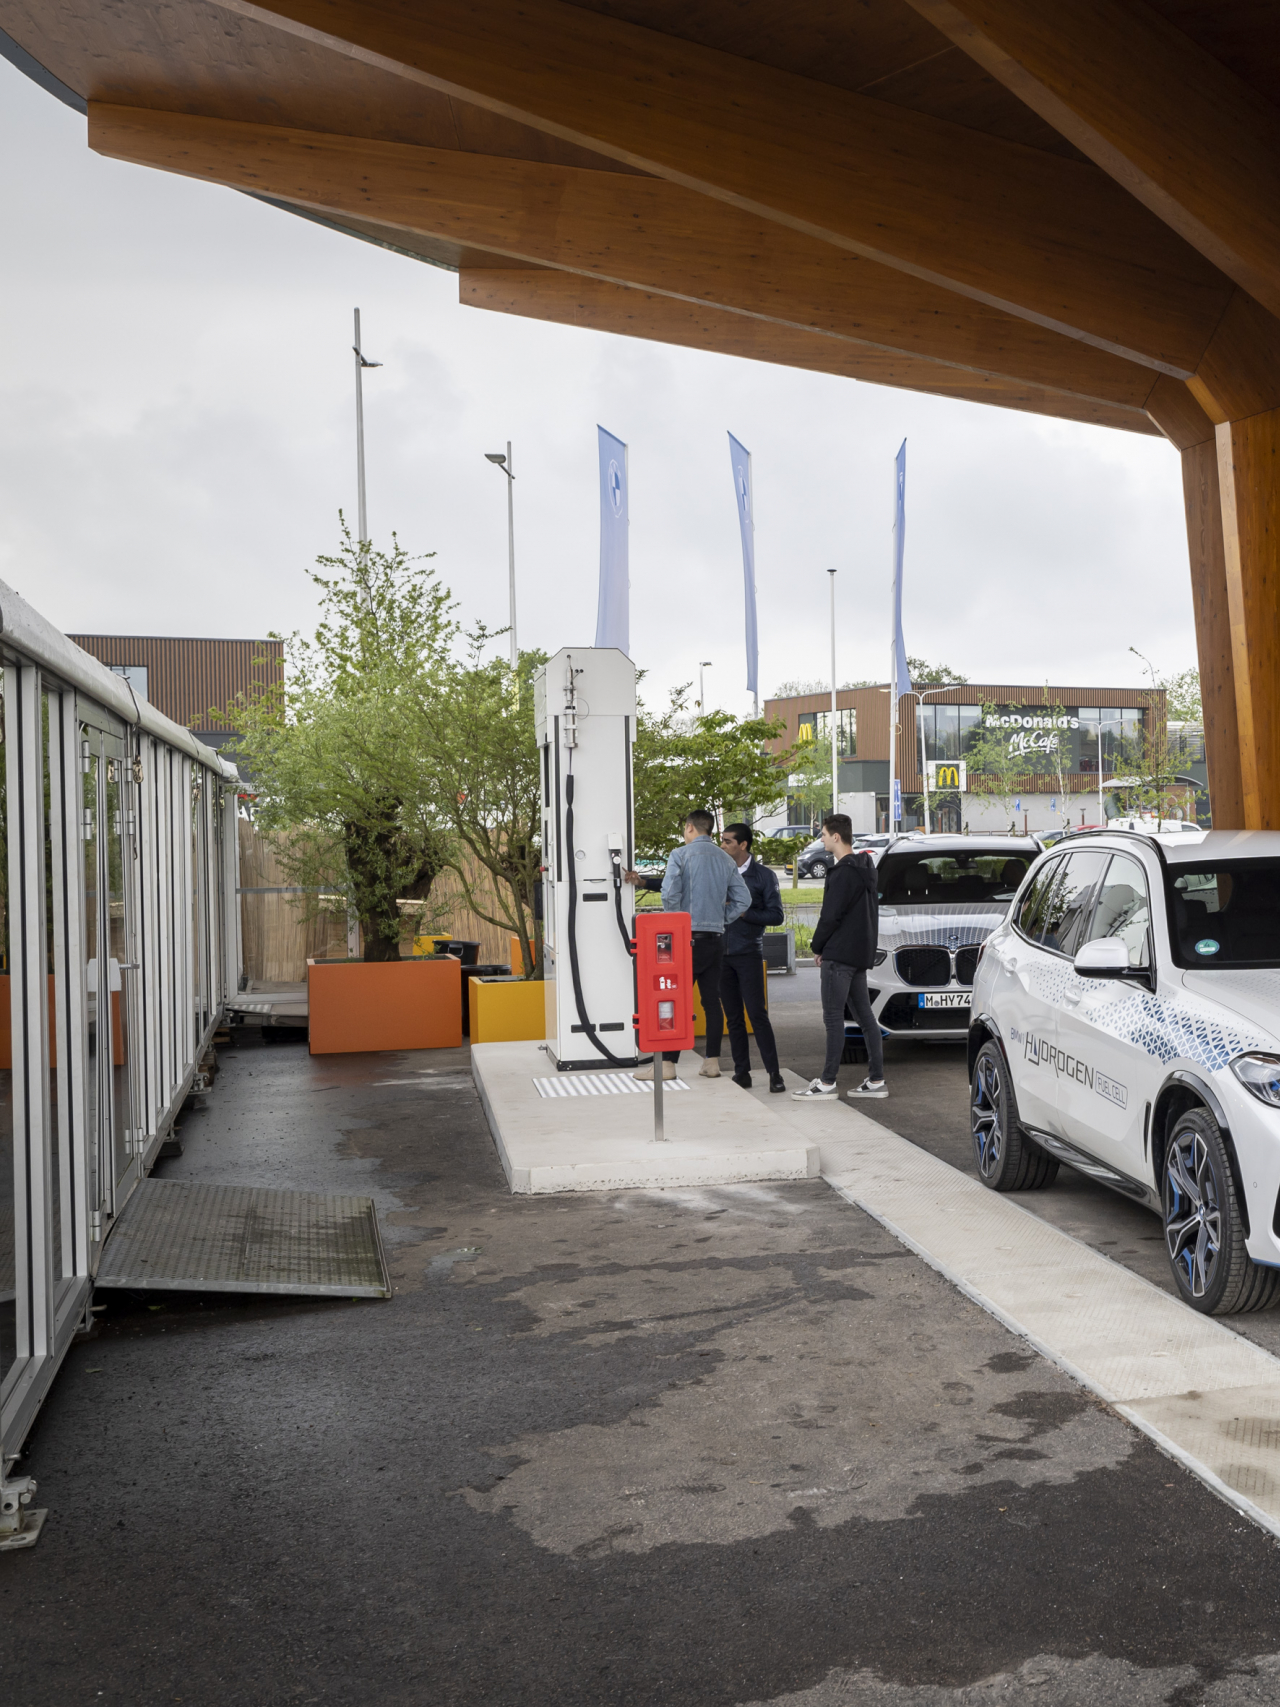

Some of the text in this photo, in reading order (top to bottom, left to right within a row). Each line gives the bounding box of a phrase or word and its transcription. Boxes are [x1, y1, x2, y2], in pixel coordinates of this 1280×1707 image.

[985, 714, 1079, 729] McDonald's
[1098, 1076, 1112, 1096] FUEL
[1112, 1084, 1126, 1105] CELL
